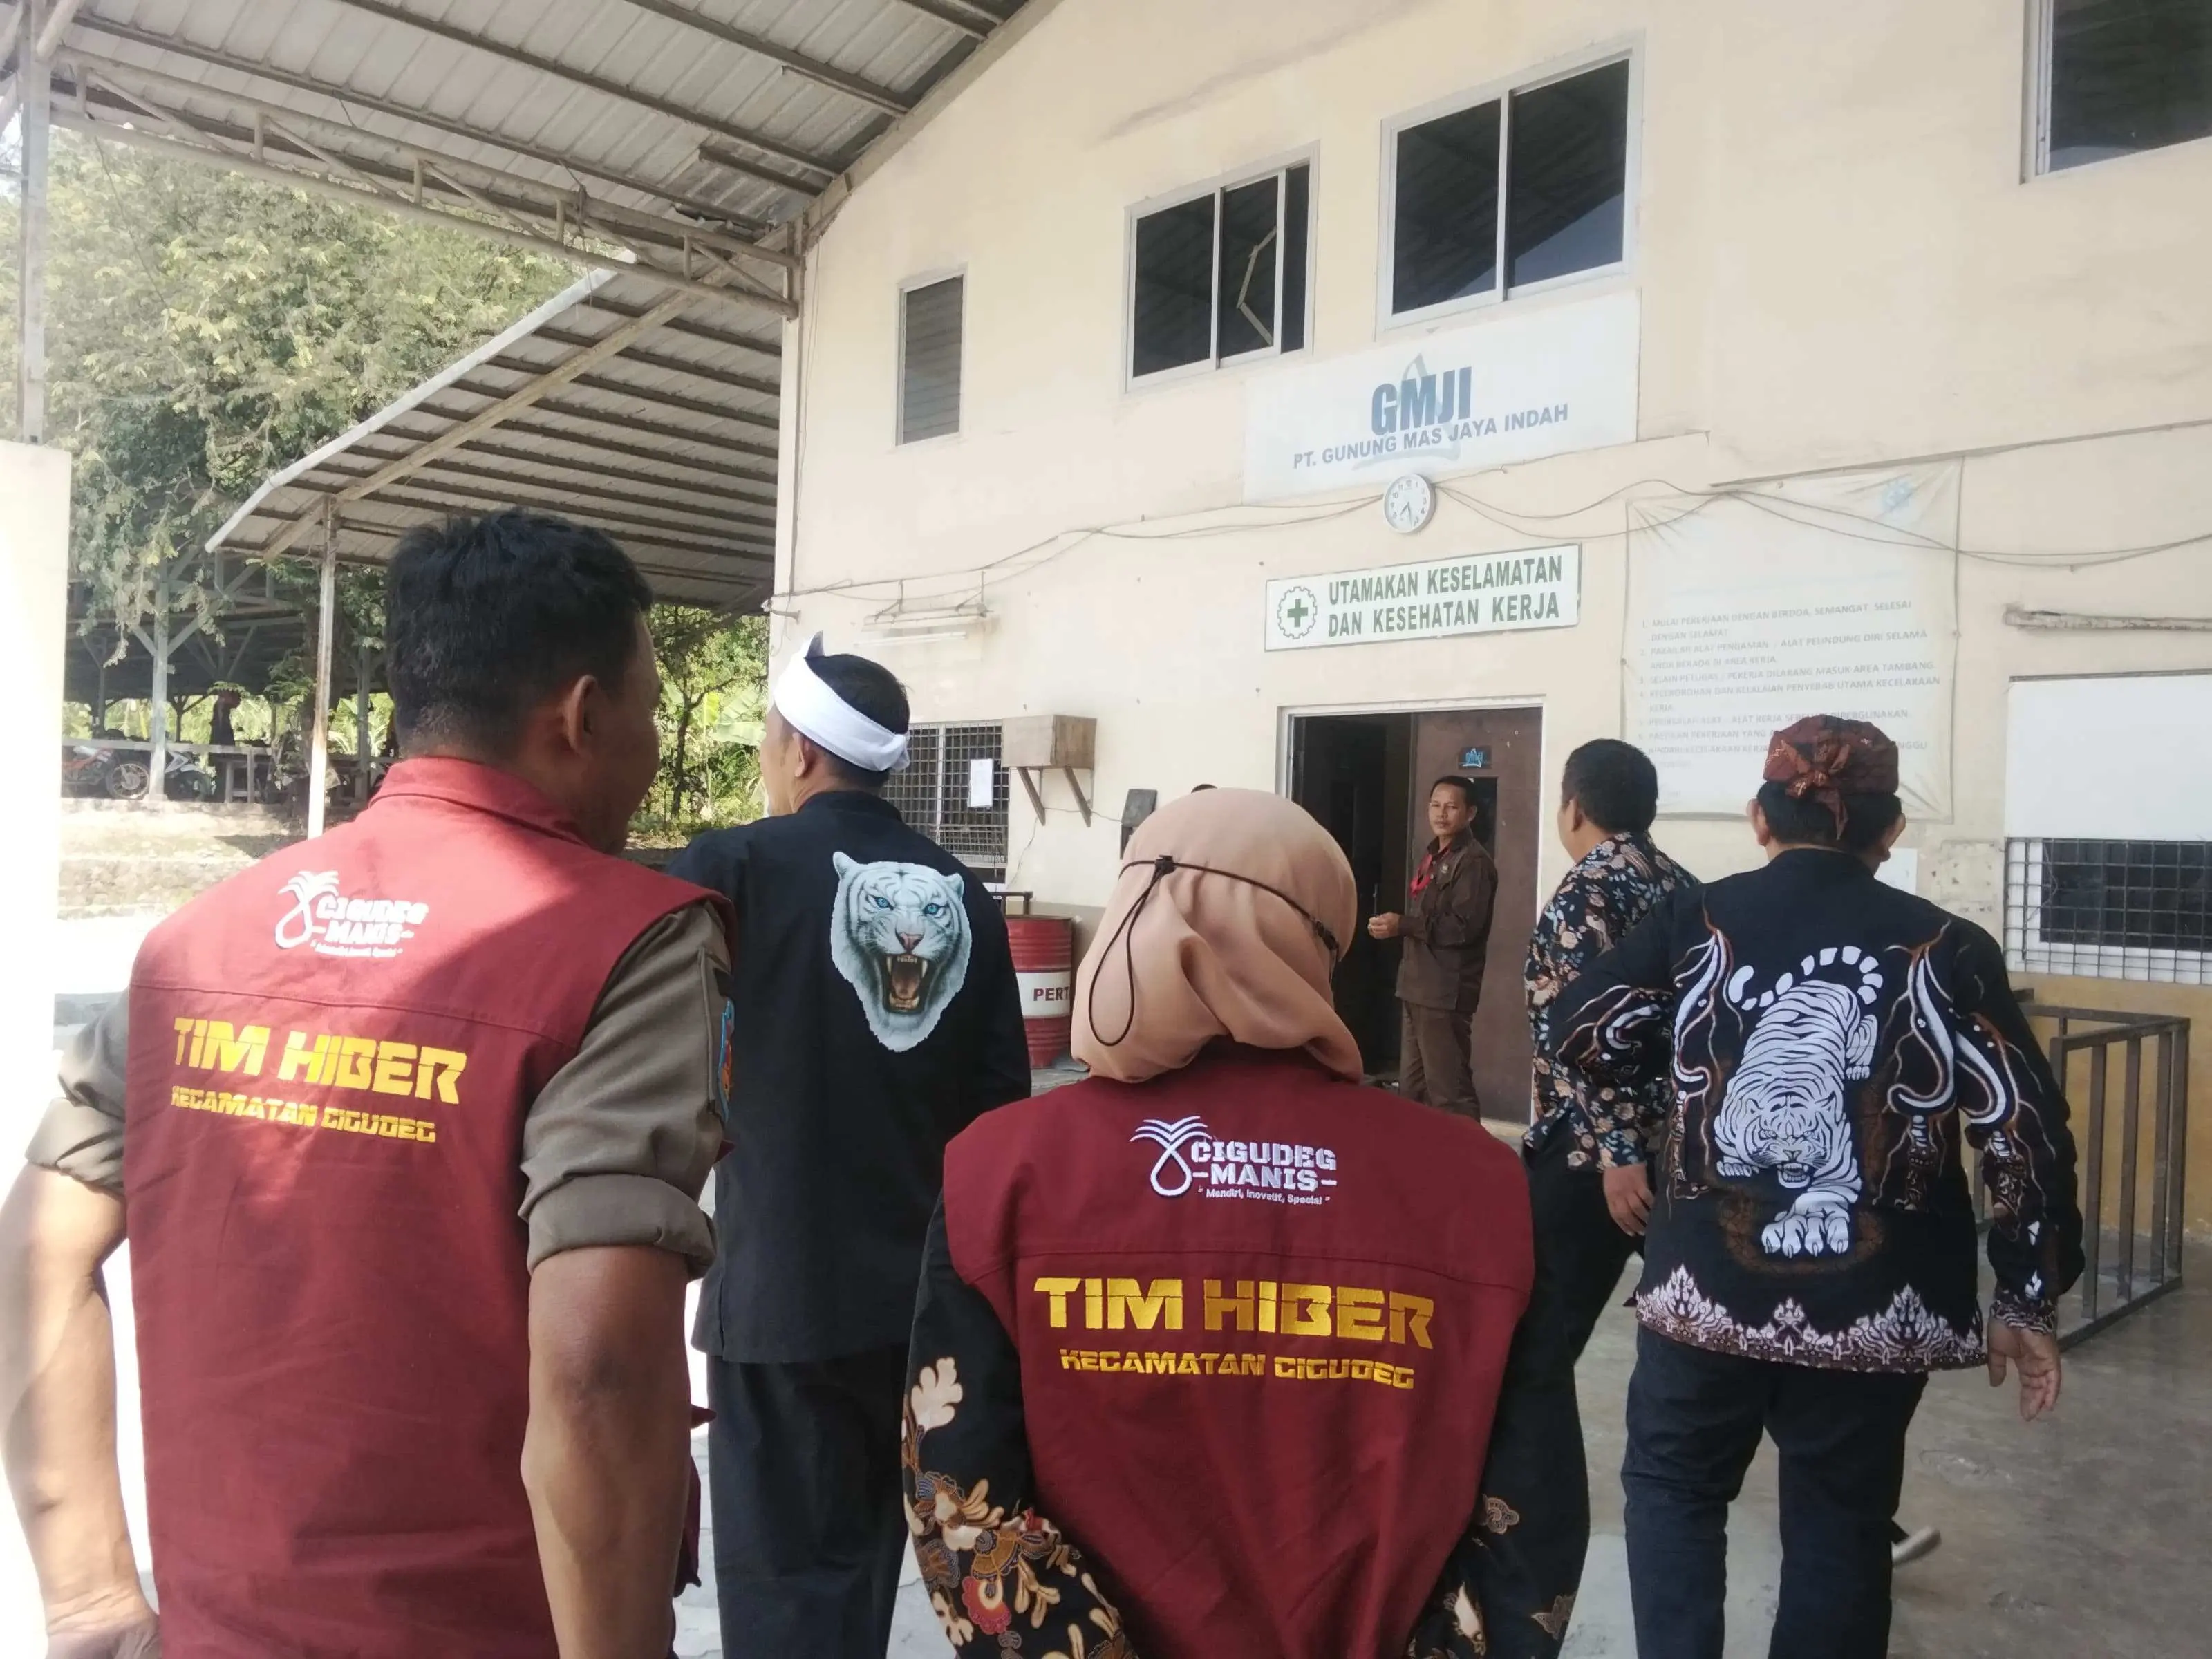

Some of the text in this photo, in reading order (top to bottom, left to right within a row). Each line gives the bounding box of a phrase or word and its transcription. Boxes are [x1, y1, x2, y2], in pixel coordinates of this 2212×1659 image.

[1371, 367, 1472, 435] GMJI
[1293, 404, 1568, 469] PT. GUNUNG MAS JAYA INDAH
[1329, 555, 1562, 605] UTAMAKAN KESELAMATAN
[1329, 592, 1559, 637] DAN KESEHATAN KERJA
[1874, 600, 1912, 612] SELESAI
[1781, 637, 1803, 648] ALAT
[1806, 634, 1861, 647] PELINDUNG
[1864, 632, 1884, 642] DIRI
[1886, 629, 1928, 641] SELAMA
[1816, 664, 1850, 676] MASUK
[1853, 663, 1880, 674] AREA
[1837, 679, 1873, 691] UTAMA
[1876, 676, 1941, 688] KECELAKAAN
[1732, 714, 1754, 724] ALAT
[174, 1018, 467, 1104] TIM HIBER
[171, 1085, 436, 1143] KECAMATAN CIGUDEG
[1191, 1141, 1337, 1170] CIGUDEG
[1034, 1277, 1434, 1350] TIM HIBER
[1060, 1349, 1415, 1389] KECAMATAN CIGUDEG
